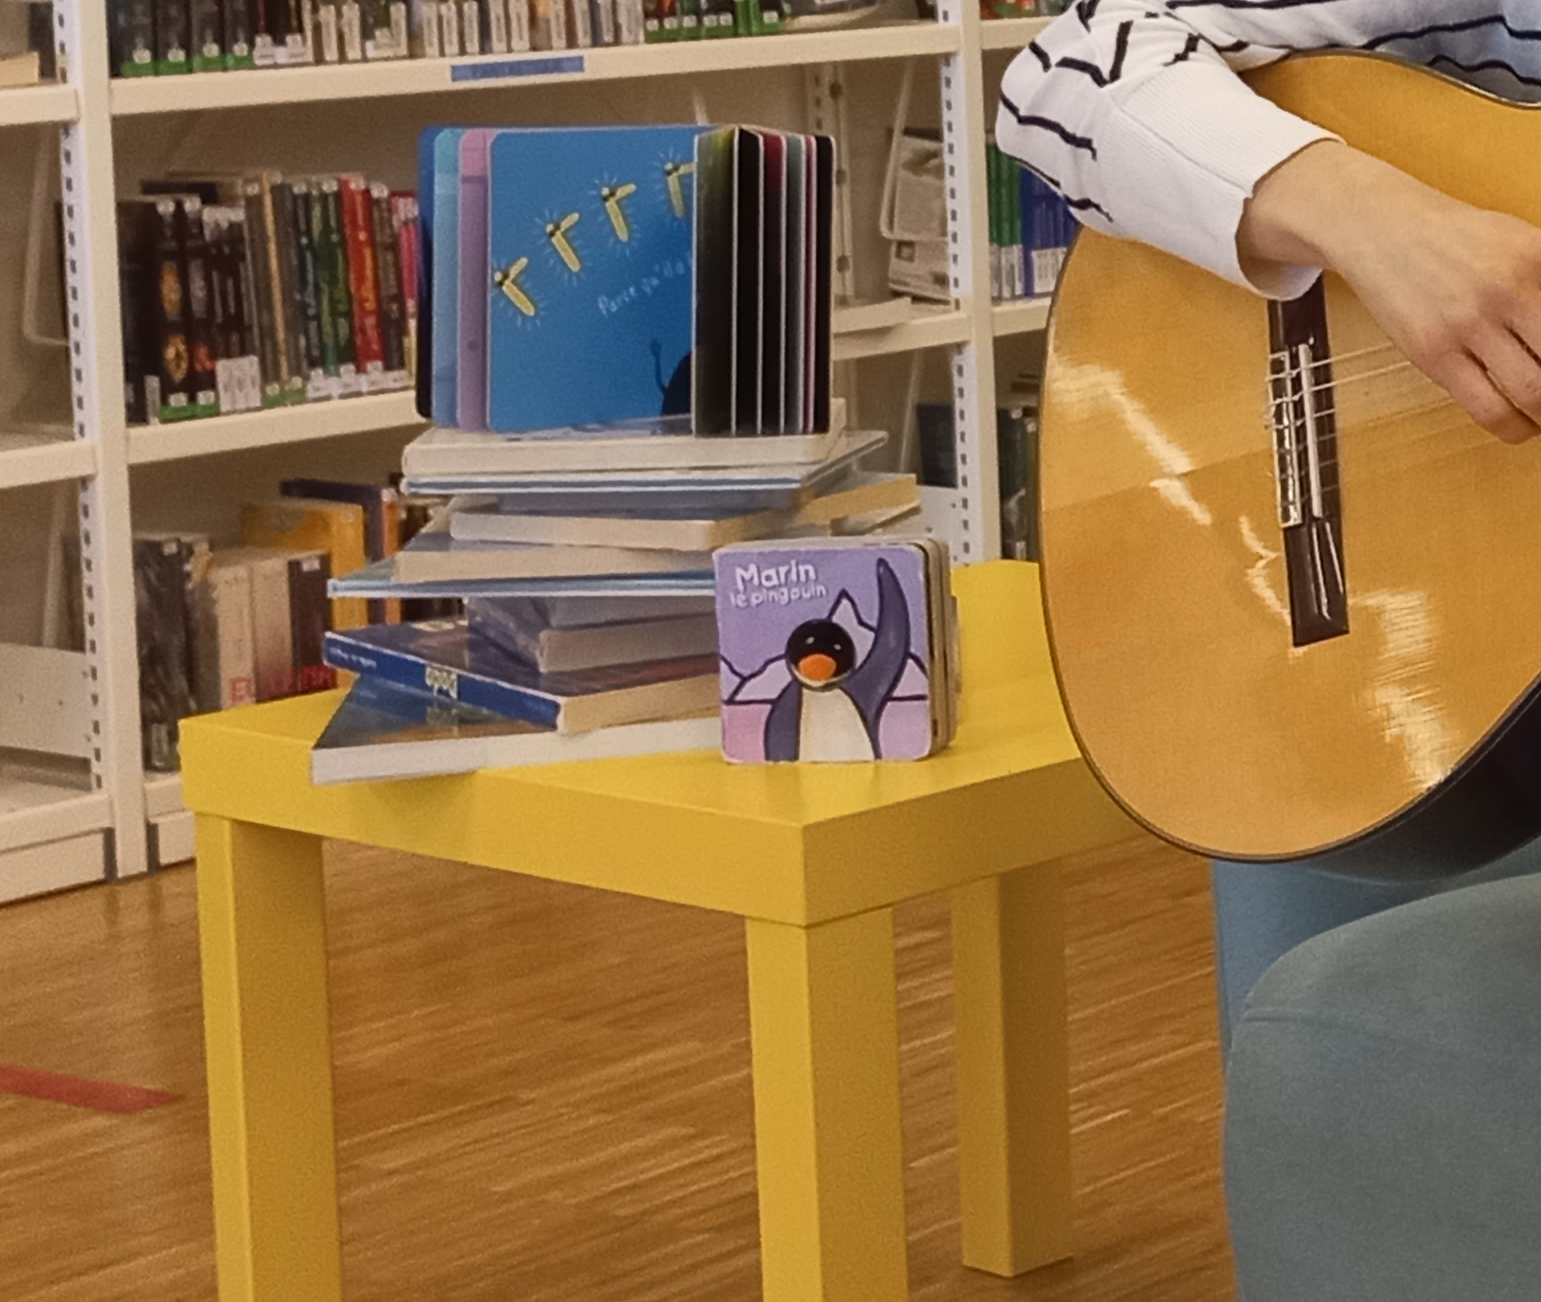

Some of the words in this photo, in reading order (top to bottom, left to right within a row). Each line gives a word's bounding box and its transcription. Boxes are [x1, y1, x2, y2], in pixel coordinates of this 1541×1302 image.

[734, 558, 817, 593] Marin
[729, 591, 749, 609] le
[750, 583, 828, 609] pingouin
